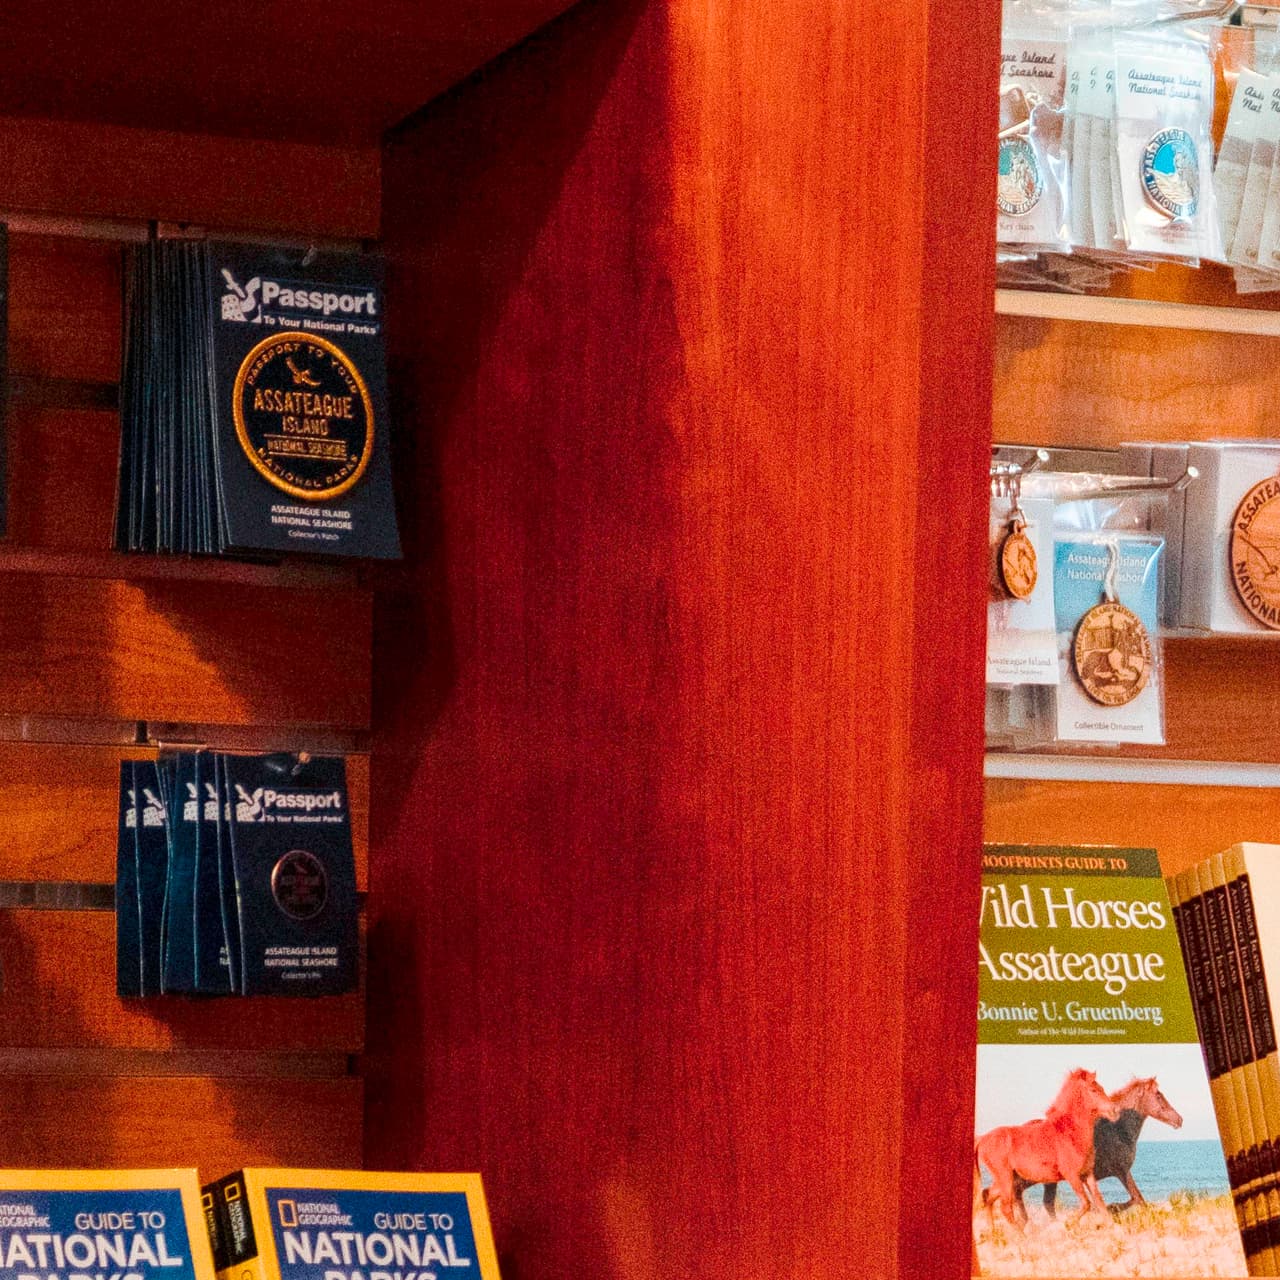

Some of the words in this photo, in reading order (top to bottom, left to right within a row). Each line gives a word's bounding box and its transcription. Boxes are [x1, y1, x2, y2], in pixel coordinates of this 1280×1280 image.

[262, 281, 376, 315] Passport
[263, 316, 276, 326] To
[279, 317, 301, 328] Your
[303, 319, 345, 332] National
[348, 323, 377, 334] Parks
[254, 388, 353, 418] ASSATEAGUE
[282, 417, 328, 436] ISLAND
[271, 505, 320, 517] ASSATEAGUE
[322, 508, 350, 519] ISLAND
[271, 516, 310, 527] NATIONAL
[312, 518, 352, 530] SEASHORE
[1074, 721, 1108, 731] Collectible
[1110, 722, 1144, 732] Ornament
[265, 790, 341, 811] Passport
[981, 856, 1062, 869] HOOFPRINTS
[1064, 858, 1105, 869] GUIDE
[1109, 859, 1127, 870] TO
[1041, 887, 1166, 929] Horses
[979, 940, 1165, 995] Assateague
[978, 1002, 1038, 1022] Bonnie
[1043, 1002, 1062, 1021] U.
[1066, 1001, 1164, 1026] Gruenberg
[297, 1203, 339, 1214] NATIONAL
[75, 1214, 135, 1230] GUIDE
[142, 1212, 165, 1229] TO
[374, 1213, 426, 1230] GUIDE
[431, 1214, 453, 1230] TO
[283, 1232, 470, 1266] NATIONAL
